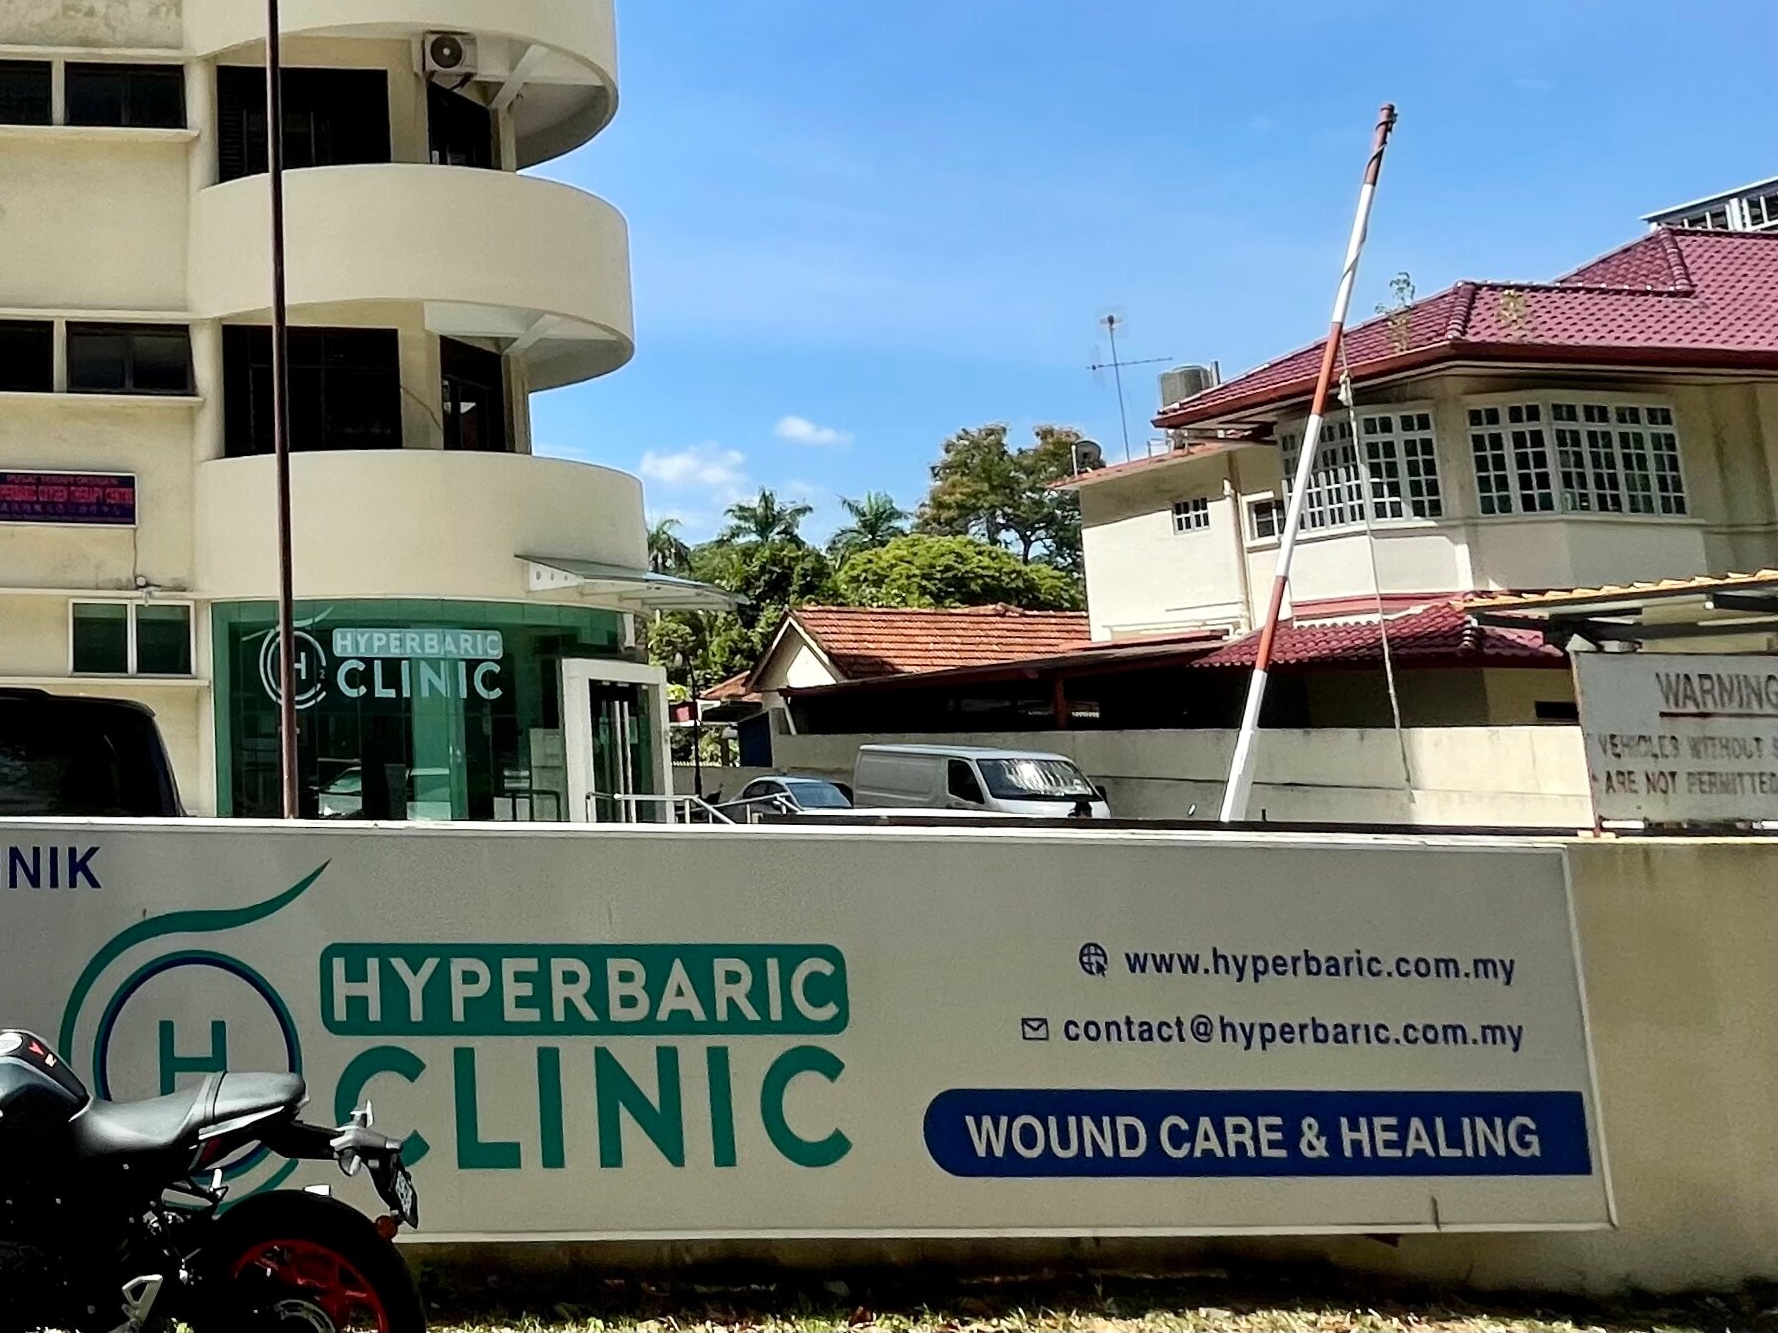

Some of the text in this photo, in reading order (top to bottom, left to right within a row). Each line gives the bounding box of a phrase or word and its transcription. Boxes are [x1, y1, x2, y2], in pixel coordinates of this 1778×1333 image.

[336, 630, 501, 656] HYPERBARIC
[337, 659, 503, 700] CLINIC
[1655, 672, 1778, 711] WARNING
[1604, 770, 1637, 795] ARE
[1645, 770, 1678, 795] NOT
[1125, 947, 1515, 985] www.hyperbaric.com.my
[332, 957, 840, 1023] HYPERBARIC
[1064, 1014, 1523, 1052] contact@hyperbaric.com.my
[159, 1020, 227, 1096] H
[334, 1045, 853, 1170] CLINIC
[965, 1115, 1541, 1158] WOUND CARE & HEALING
